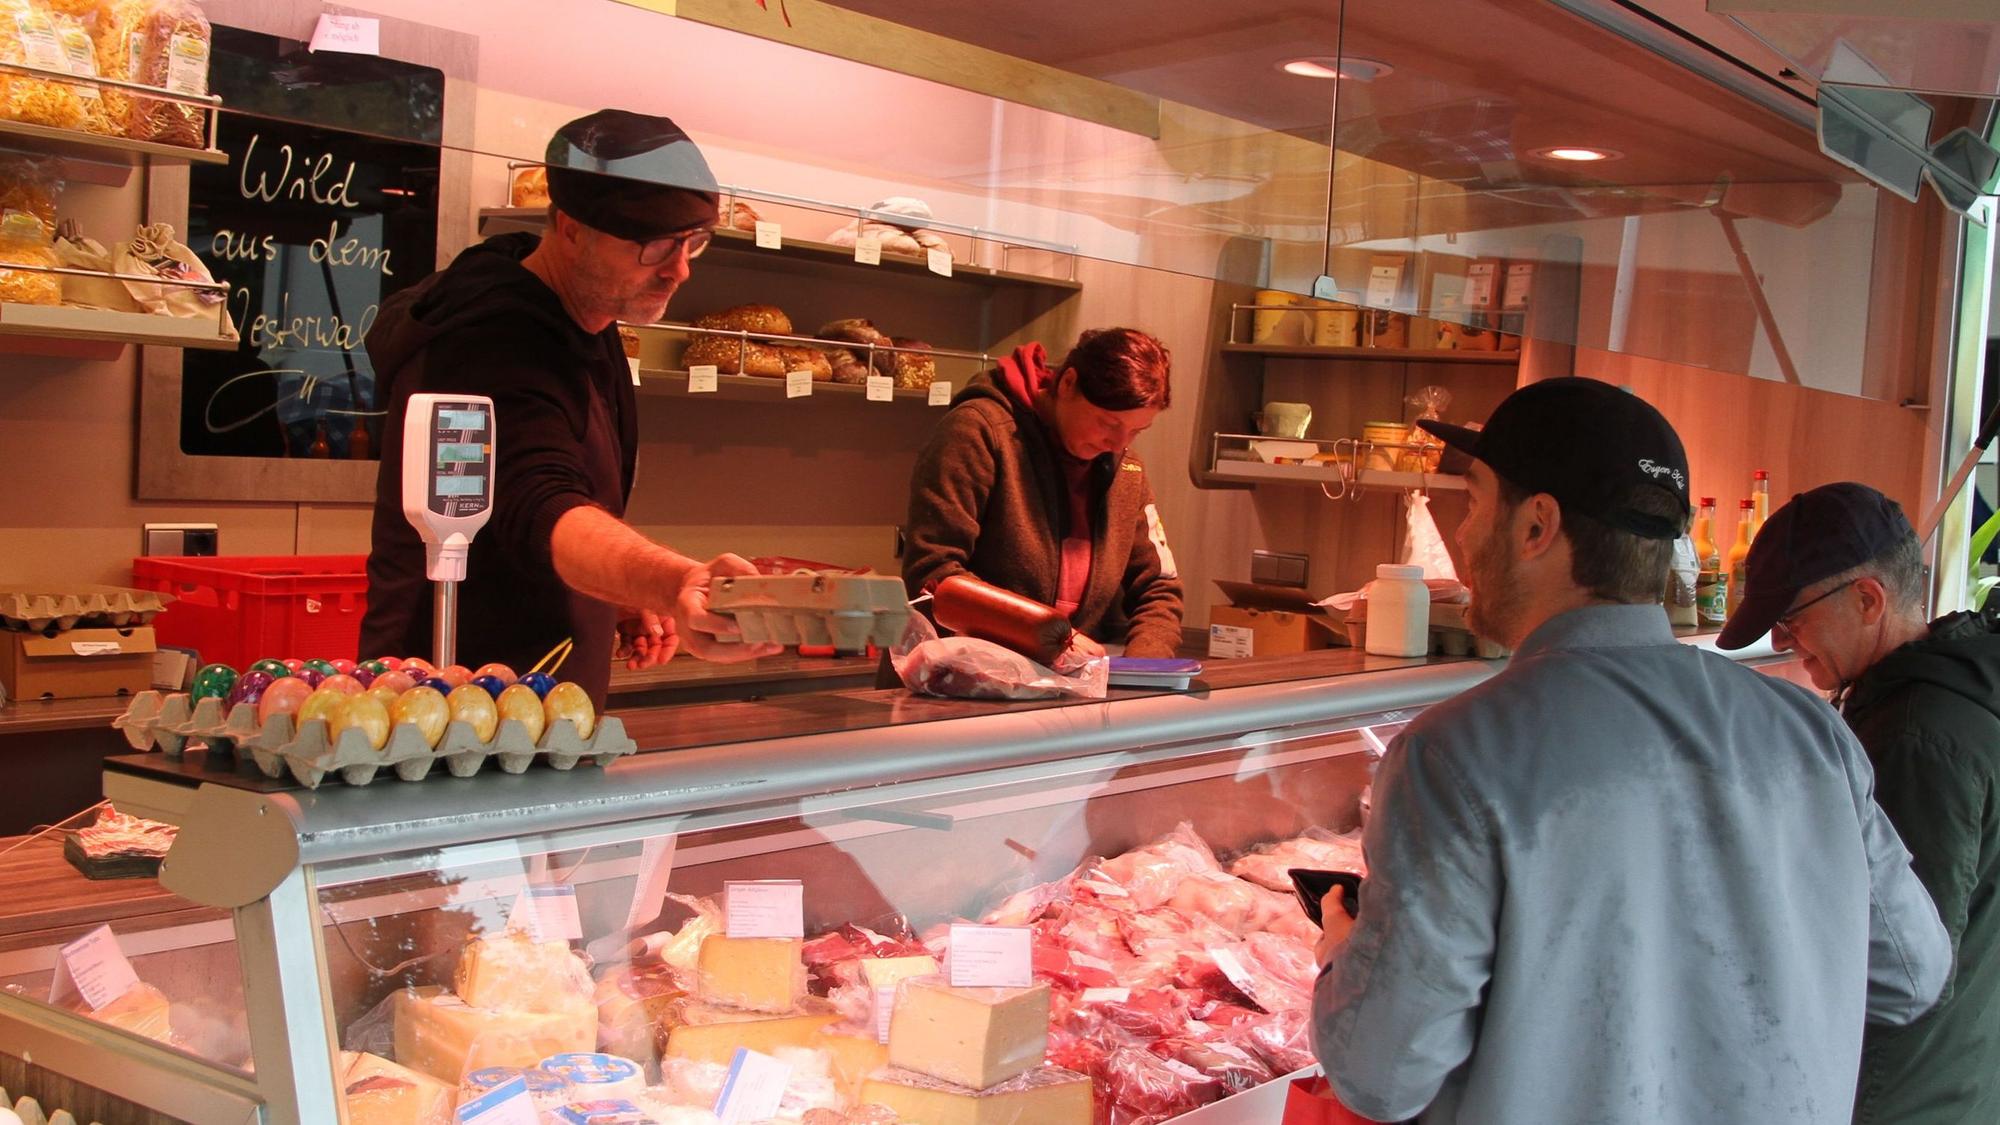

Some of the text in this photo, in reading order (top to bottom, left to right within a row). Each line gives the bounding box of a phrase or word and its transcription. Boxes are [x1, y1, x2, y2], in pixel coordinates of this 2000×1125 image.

[239, 133, 359, 207] Wild
[211, 220, 393, 276] aus dem
